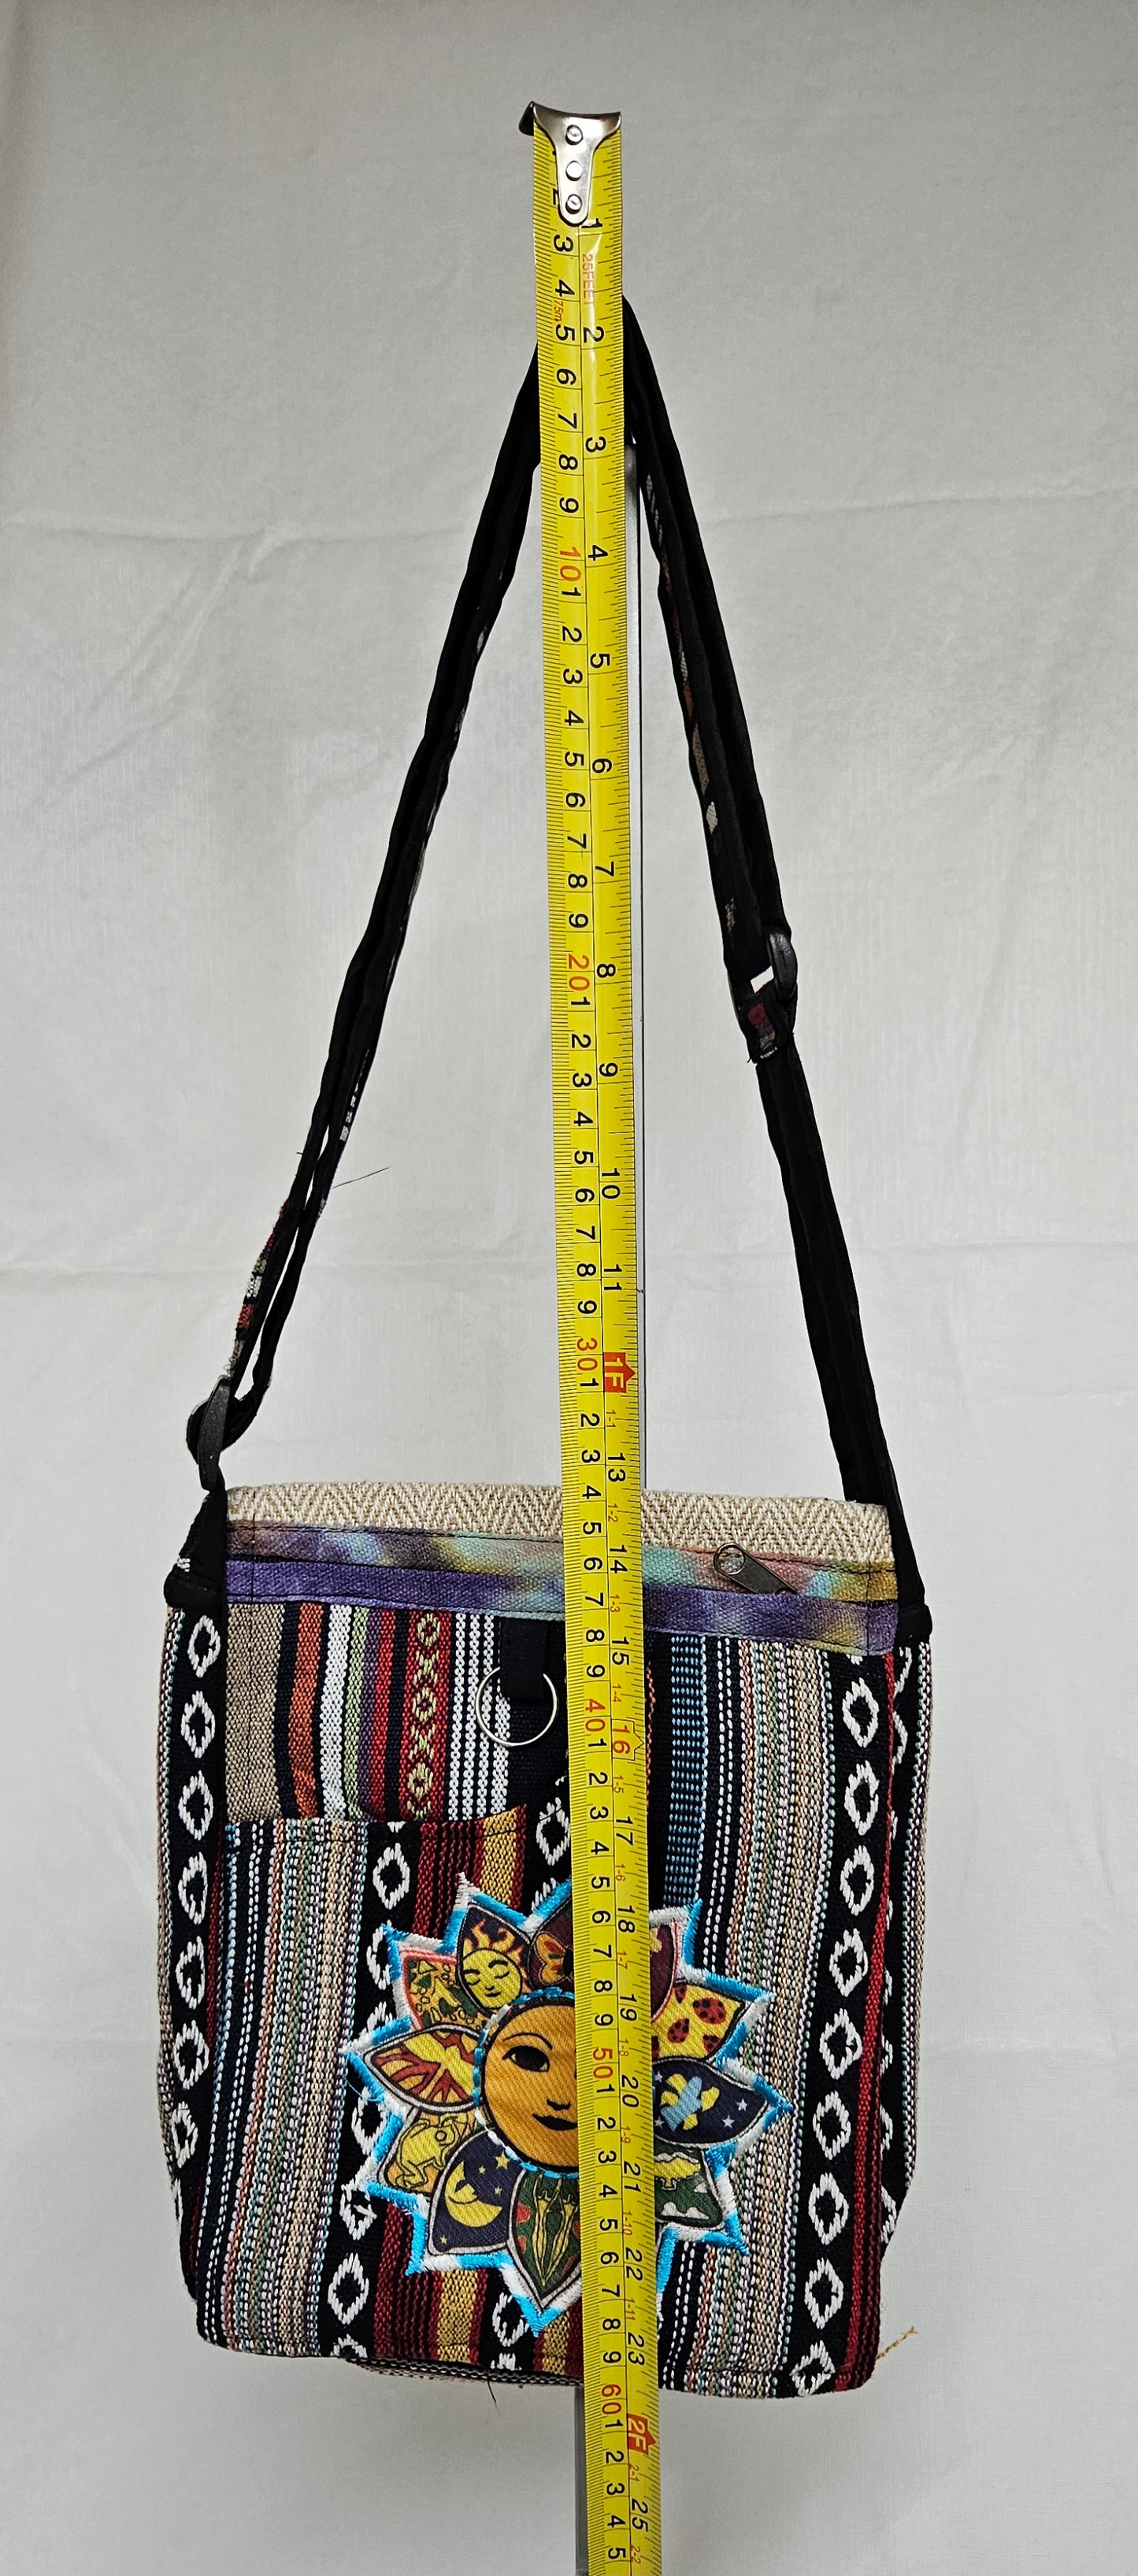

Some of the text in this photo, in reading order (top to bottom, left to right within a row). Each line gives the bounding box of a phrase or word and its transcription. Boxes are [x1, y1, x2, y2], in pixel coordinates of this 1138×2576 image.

[581, 217, 603, 228] 1
[554, 235, 574, 252] 3
[555, 279, 575, 297] 4
[556, 324, 575, 341] 5
[583, 327, 604, 343] 2
[557, 369, 576, 384] 6
[558, 413, 576, 428] 7
[585, 437, 606, 453] 3
[558, 454, 578, 470] 8
[560, 498, 579, 513] 9
[588, 545, 608, 561] 4
[560, 547, 581, 581] 10
[562, 587, 581, 596] 1
[562, 626, 582, 642] 2
[591, 653, 610, 668] 5
[563, 669, 582, 684] 3
[565, 710, 584, 725] 4
[565, 752, 584, 766] 5
[592, 758, 612, 773] 6
[565, 792, 585, 808] 6
[567, 833, 586, 848] 7
[595, 862, 613, 877] 7
[568, 874, 588, 888] 8
[569, 914, 588, 928] 9
[569, 954, 589, 991] 20
[597, 964, 616, 977] 8
[571, 997, 590, 1006] 1
[572, 1034, 591, 1048] 2
[599, 1062, 618, 1077] 9
[573, 1073, 591, 1088] 3
[573, 1111, 593, 1126] 4
[574, 1151, 594, 1165] 5
[602, 1168, 621, 1199] 10
[575, 1188, 595, 1203] 6
[576, 1226, 595, 1240] 7
[576, 1263, 596, 1277] 8
[603, 1264, 622, 1291] 11
[577, 1300, 597, 1314] 9
[576, 1338, 598, 1371] 30
[605, 1358, 625, 1388] 1F
[580, 1378, 599, 1387] 1
[580, 1413, 600, 1427] 2
[606, 1410, 616, 1427] 1-1
[581, 1450, 600, 1463] 3
[608, 1453, 625, 1482] 13
[582, 1486, 601, 1499] 4
[607, 1503, 618, 1522] 1-2
[583, 1522, 602, 1535] 5
[584, 1557, 602, 1570] 6
[610, 1545, 628, 1573] 14
[585, 1592, 603, 1606] 7
[610, 1595, 620, 1612] 1-3
[586, 1629, 604, 1642] 8
[611, 1637, 629, 1666] 15
[587, 1665, 605, 1677] 9
[612, 1685, 621, 1702] 1-4
[585, 1699, 605, 1732] 40
[588, 1739, 607, 1748] 1
[612, 1725, 630, 1754] 16
[588, 1772, 608, 1785] 2
[613, 1775, 624, 1793] 1-5
[590, 1807, 609, 1820] 3
[616, 1817, 633, 1845] 17
[591, 1841, 610, 1855] 4
[615, 1864, 625, 1881] 1-6
[591, 1877, 610, 1889] 5
[592, 1911, 610, 1923] 6
[617, 1905, 635, 1933] 18
[594, 1945, 612, 1958] 7
[617, 1951, 628, 1969] 1-7
[594, 1980, 613, 1992] 8
[620, 1994, 637, 2022] 19
[595, 2014, 613, 2026] 9
[619, 2038, 628, 2056] 1-8
[593, 2048, 613, 2079] 50
[597, 2085, 615, 2093] 1
[621, 2074, 639, 2107] 20
[597, 2117, 616, 2130] 2
[621, 2126, 630, 2143] 1-9
[599, 2151, 617, 2163] 3
[623, 2161, 641, 2192] 21
[599, 2185, 617, 2197] 4
[599, 2218, 617, 2232] 5
[623, 2211, 632, 2235] 1-10
[601, 2252, 619, 2265] 6
[625, 2247, 643, 2281] 22
[602, 2285, 620, 2297] 7
[625, 2298, 636, 2321] 1-11
[602, 2318, 621, 2330] 8
[628, 2332, 645, 2365] 23
[603, 2352, 621, 2363] 9
[602, 2384, 621, 2415] 60
[605, 2419, 623, 2428] 1
[628, 2418, 646, 2451] 2F
[606, 2451, 624, 2463] 2
[629, 2463, 639, 2481] 2-1
[607, 2483, 625, 2495] 3
[607, 2515, 625, 2527] 4
[632, 2499, 648, 2531] 25
[608, 2548, 625, 2559] 5
[631, 2545, 641, 2564] 2-2
